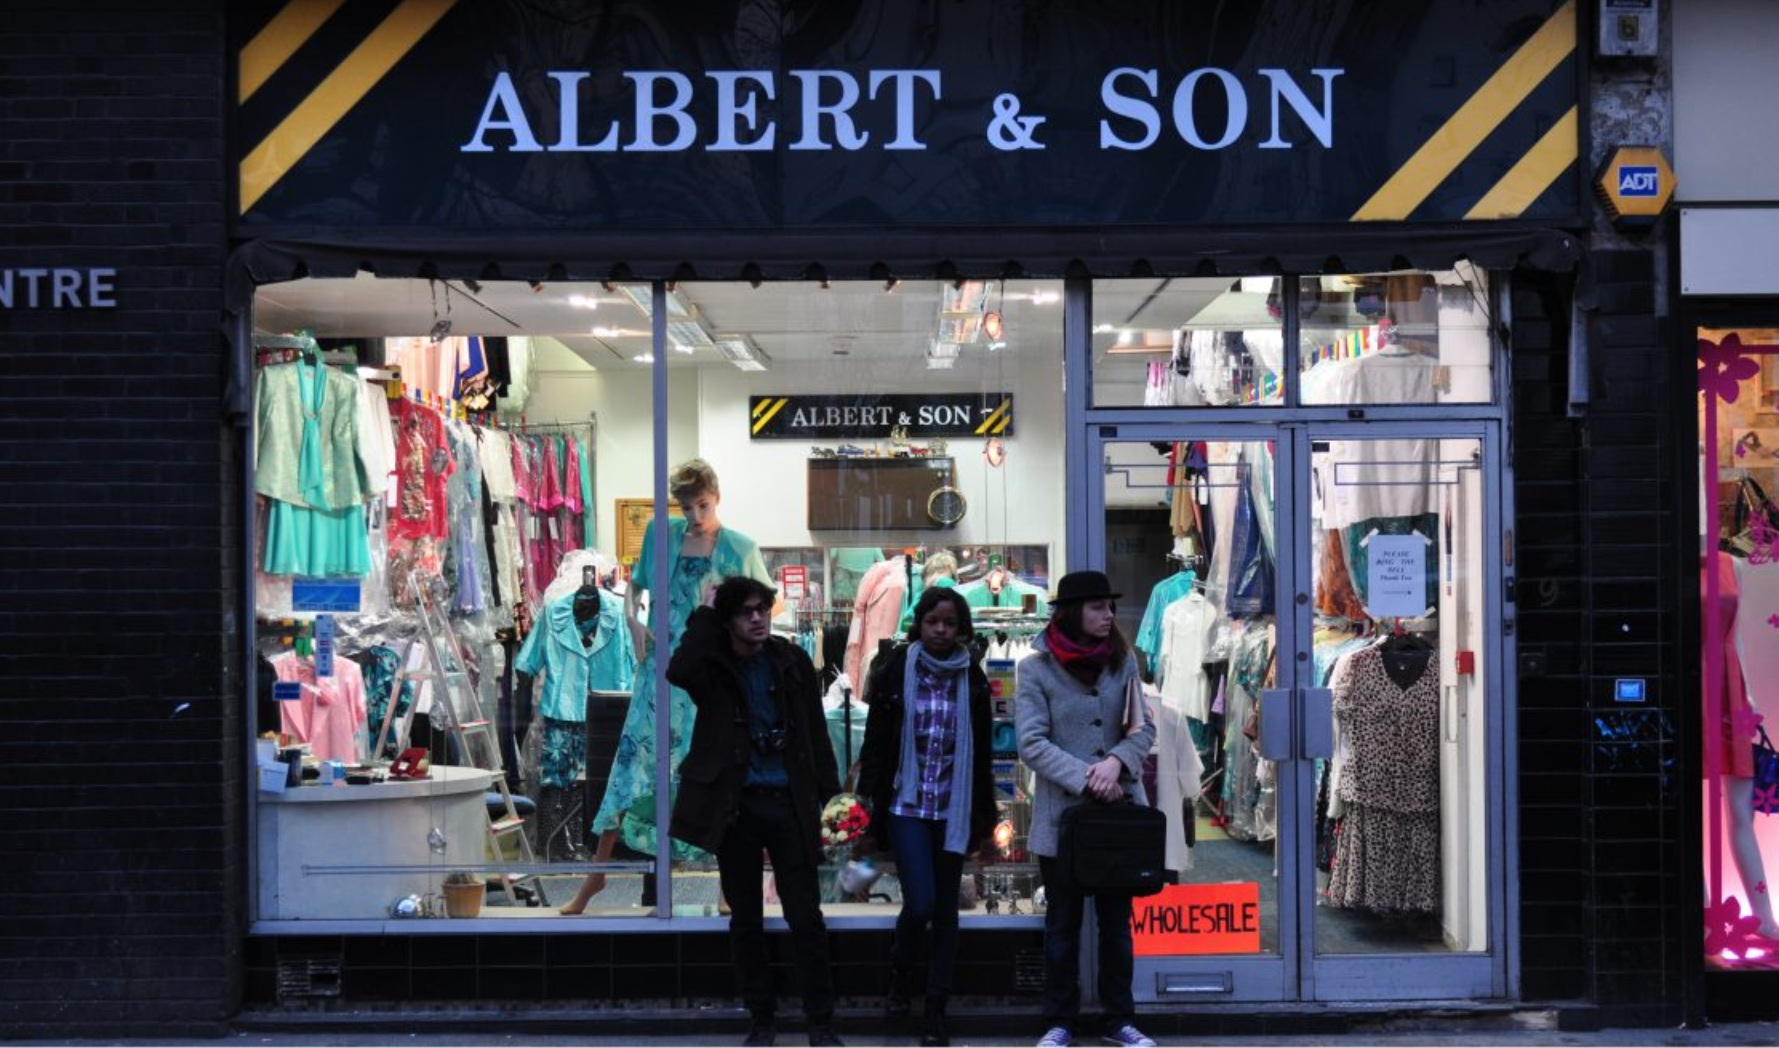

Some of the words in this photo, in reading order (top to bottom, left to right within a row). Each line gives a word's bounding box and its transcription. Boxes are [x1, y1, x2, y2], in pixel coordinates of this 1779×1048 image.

[460, 70, 942, 152] ALBERT
[986, 93, 1046, 151] &
[1100, 67, 1345, 150] SON
[1619, 173, 1658, 190] ADT
[791, 406, 893, 427] ALBERT
[898, 411, 911, 425] &
[919, 405, 971, 425] SON
[1538, 576, 1559, 607] 9
[1131, 903, 1257, 934] WHOLESALE
